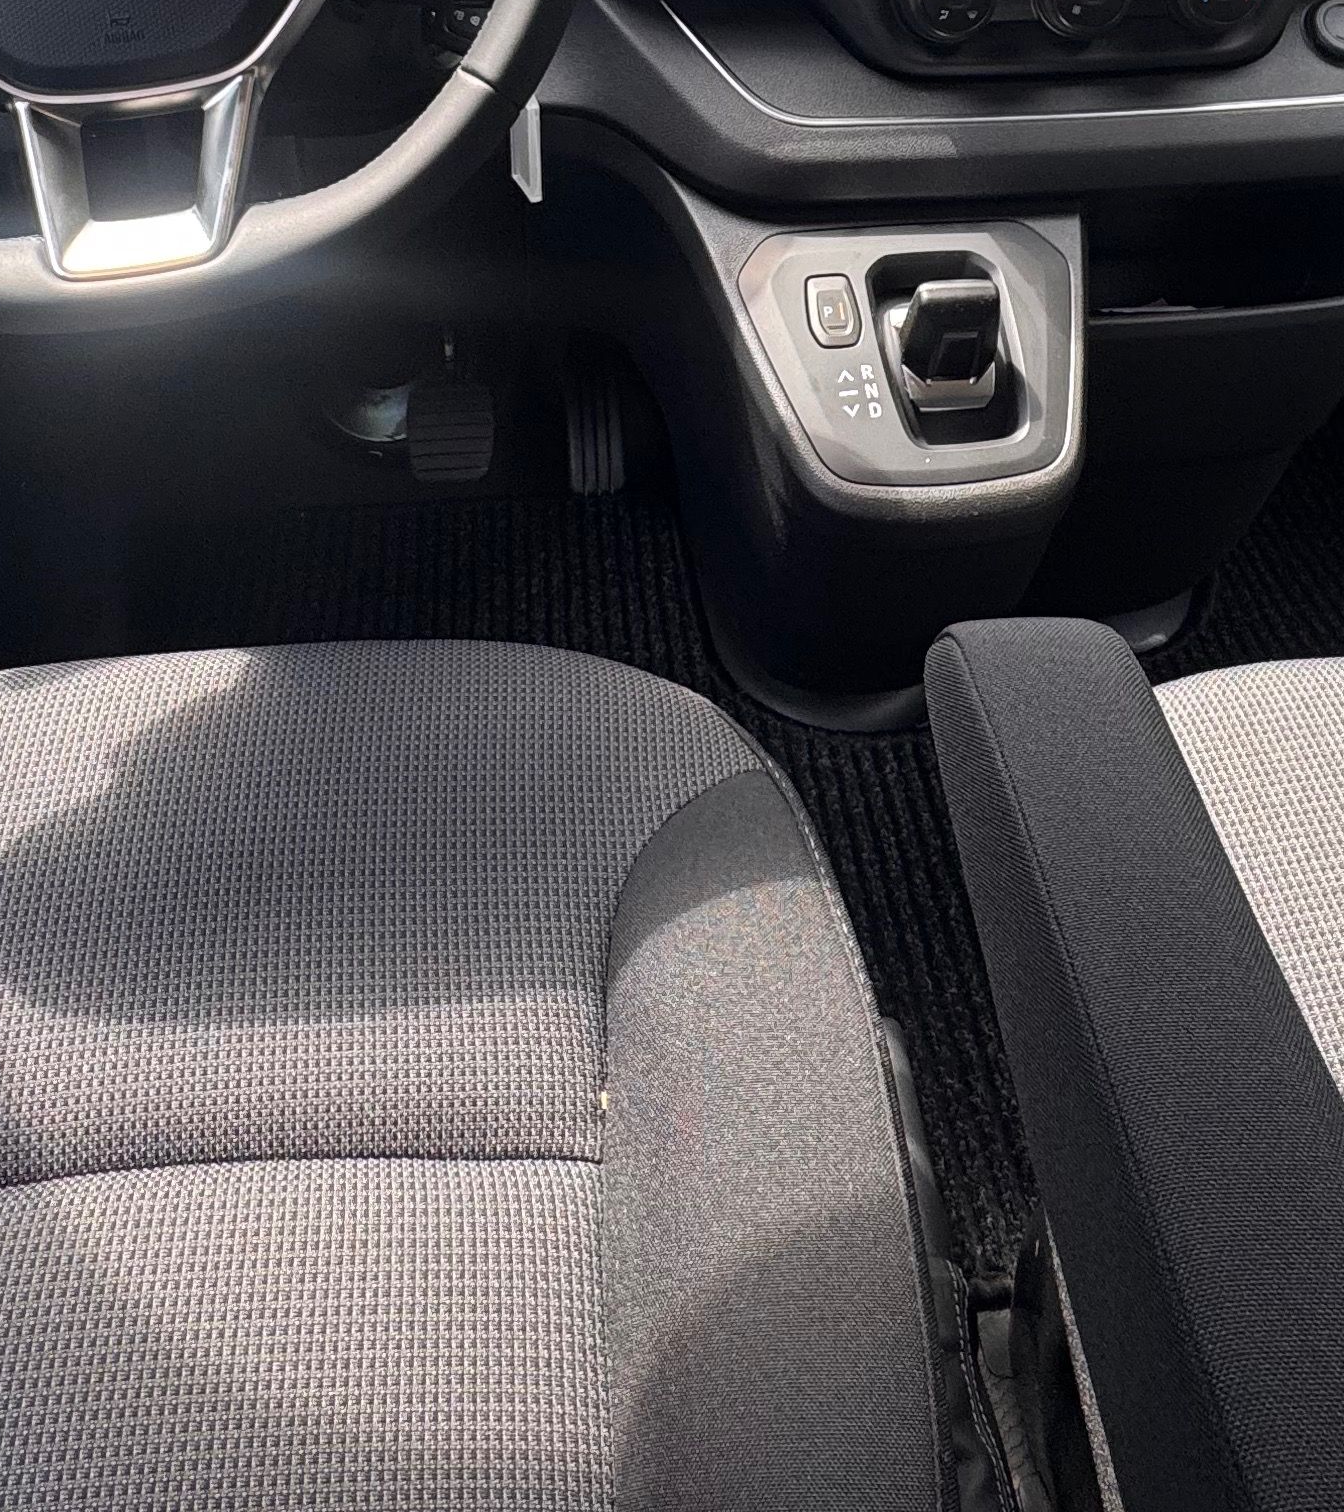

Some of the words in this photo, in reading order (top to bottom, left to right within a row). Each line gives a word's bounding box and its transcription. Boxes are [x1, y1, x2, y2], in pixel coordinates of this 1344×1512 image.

[822, 305, 834, 319] P
[860, 364, 875, 380] R
[864, 383, 880, 399] N
[868, 401, 883, 419] D
